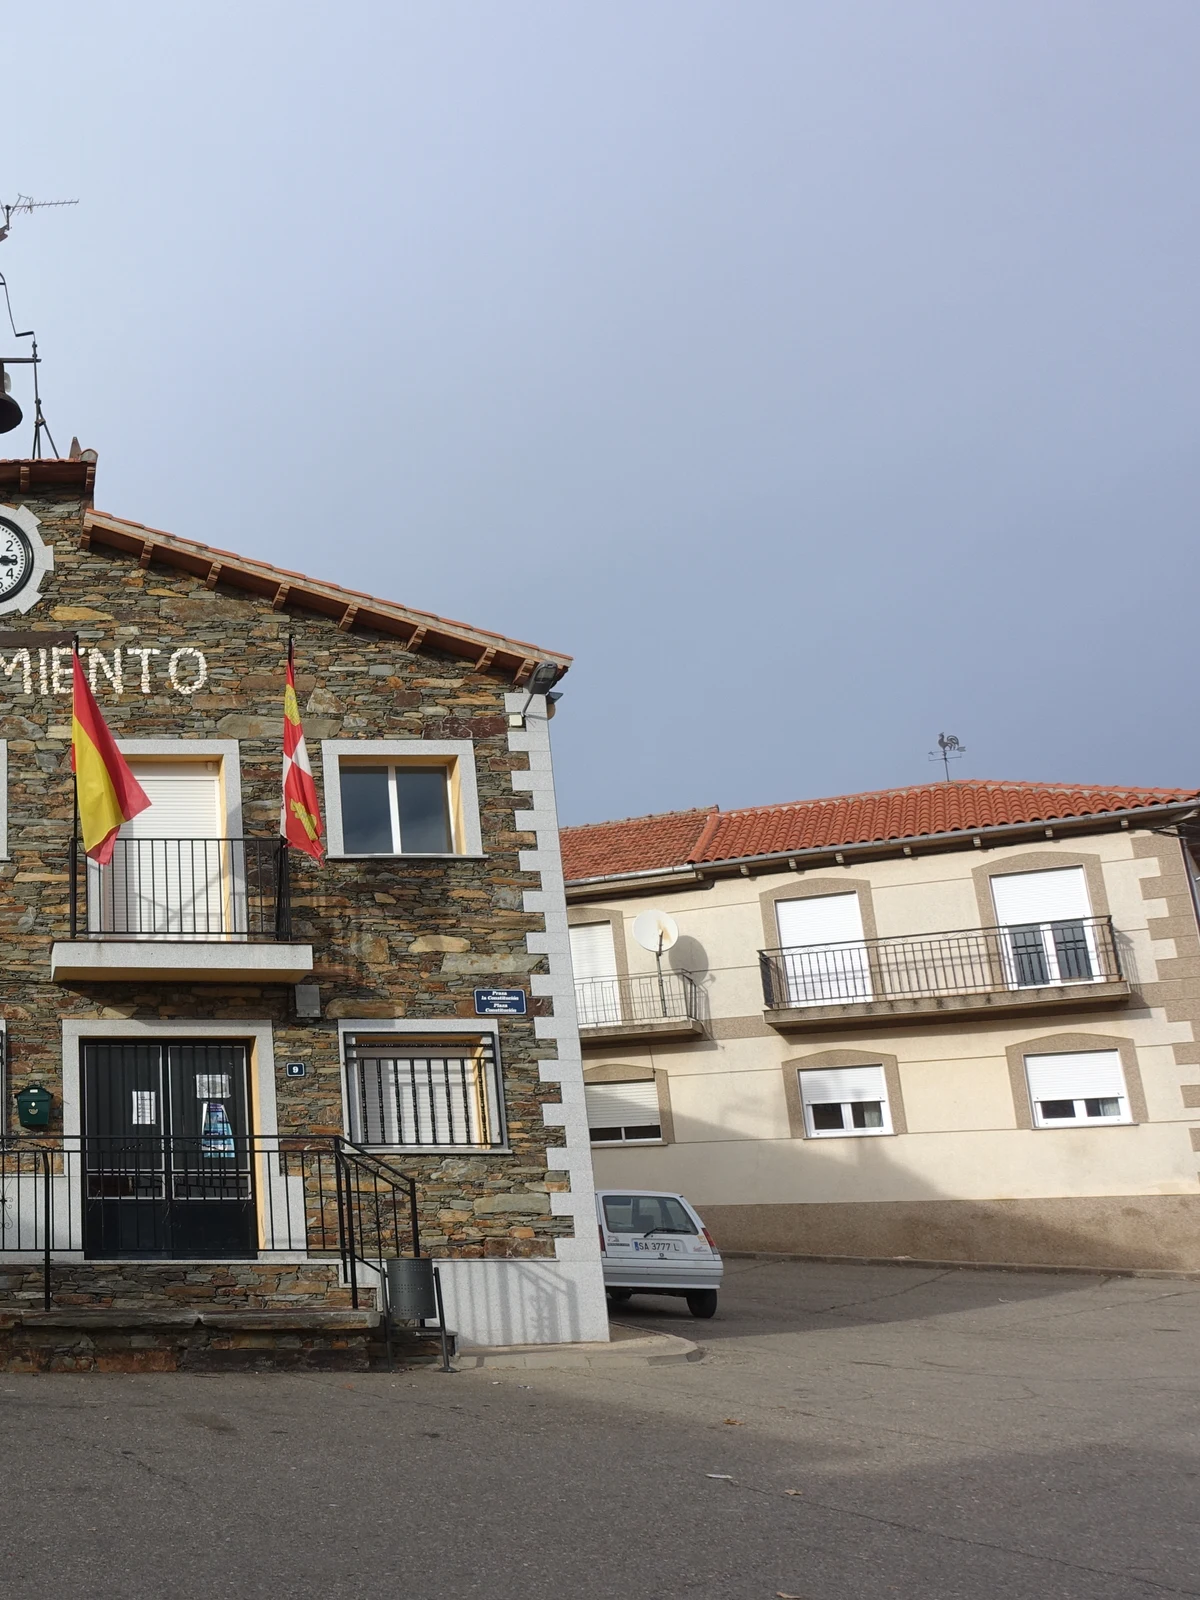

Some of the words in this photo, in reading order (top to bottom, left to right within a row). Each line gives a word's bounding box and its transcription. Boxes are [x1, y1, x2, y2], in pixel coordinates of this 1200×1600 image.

[5, 539, 14, 552] 2
[10, 554, 19, 566] 3
[5, 567, 14, 580] 4
[292, 1066, 299, 1074] 9
[638, 1242, 650, 1251] SA
[650, 1242, 671, 1251] 3777
[673, 1243, 680, 1252] L
